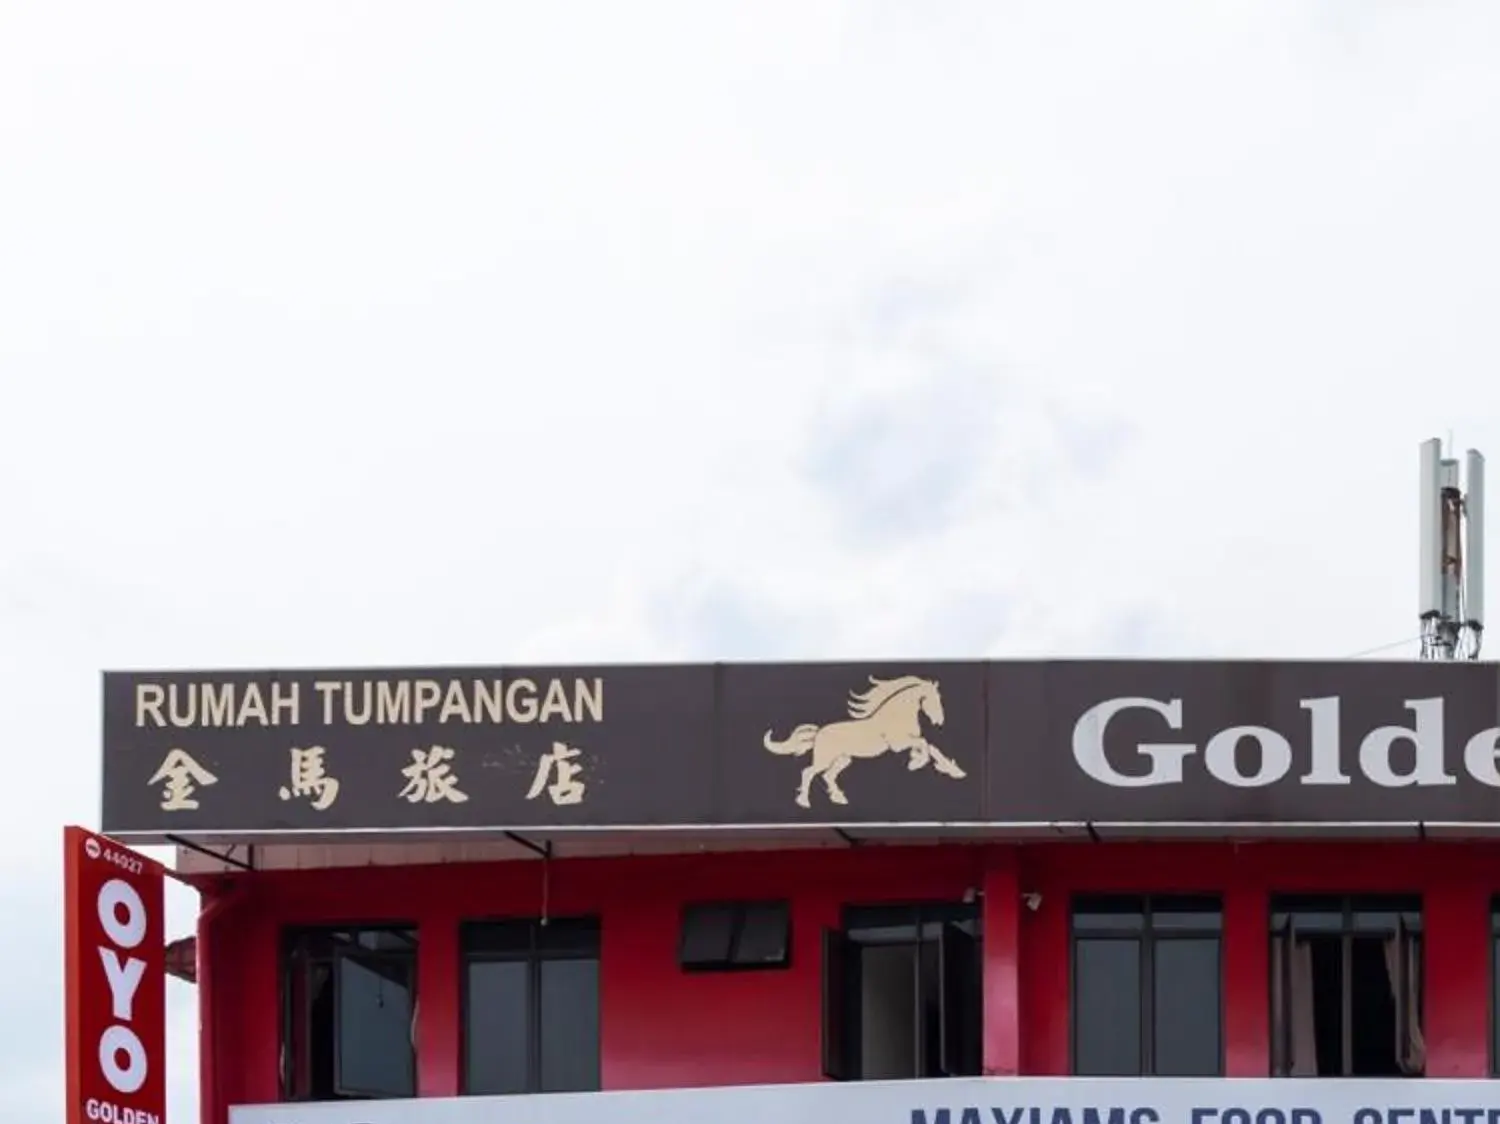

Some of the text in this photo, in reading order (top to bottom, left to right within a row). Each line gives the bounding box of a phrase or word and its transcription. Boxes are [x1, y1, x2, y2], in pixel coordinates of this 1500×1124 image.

[135, 677, 605, 728] RUMAH TUMPANGAN
[148, 741, 586, 811] 金馬旅店
[96, 878, 149, 1093] OYO
